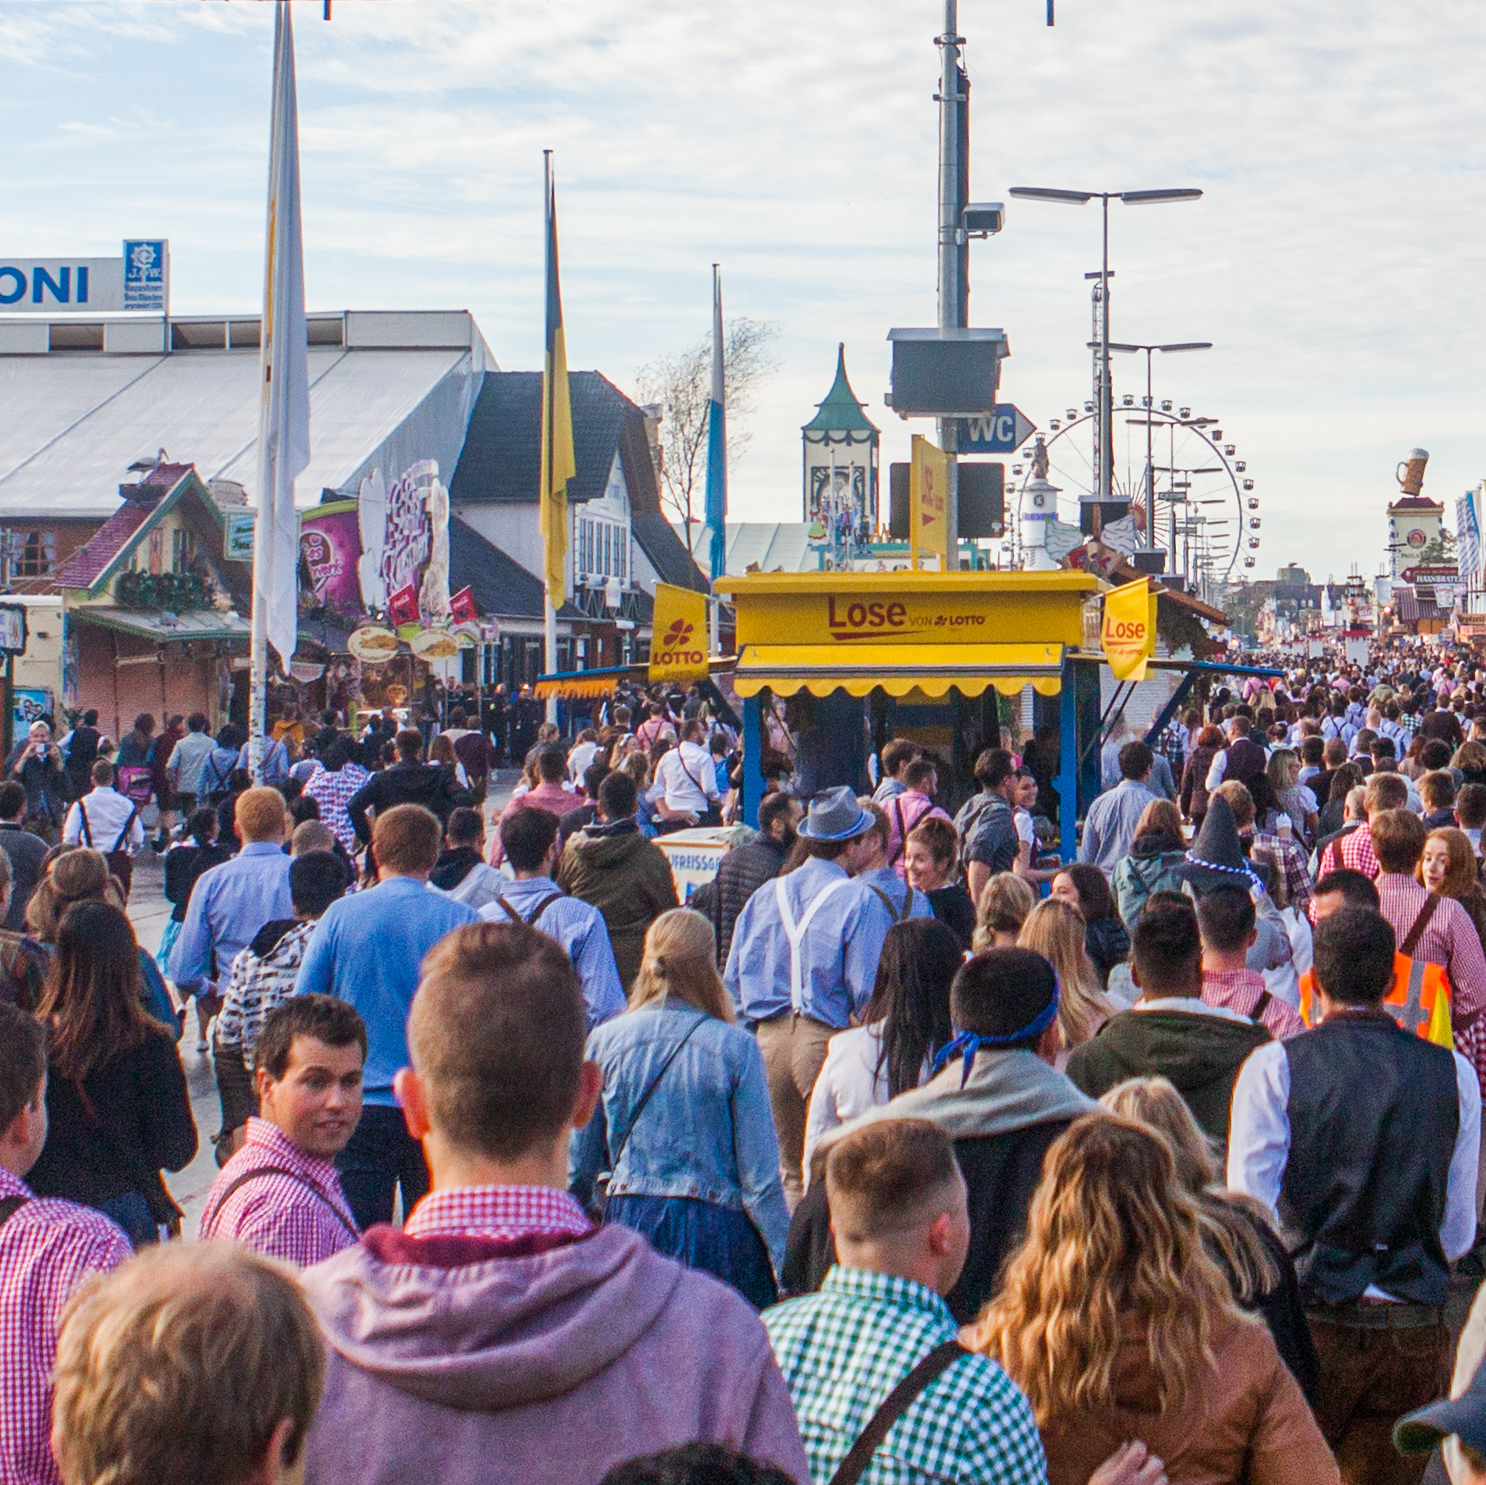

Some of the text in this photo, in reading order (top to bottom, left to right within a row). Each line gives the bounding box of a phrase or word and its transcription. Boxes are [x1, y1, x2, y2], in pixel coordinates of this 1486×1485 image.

[967, 415, 1013, 443] WC
[828, 595, 907, 627] Lose
[949, 615, 986, 626] LOTTO
[1105, 617, 1145, 639] Lose
[654, 650, 704, 665] LOTTO
